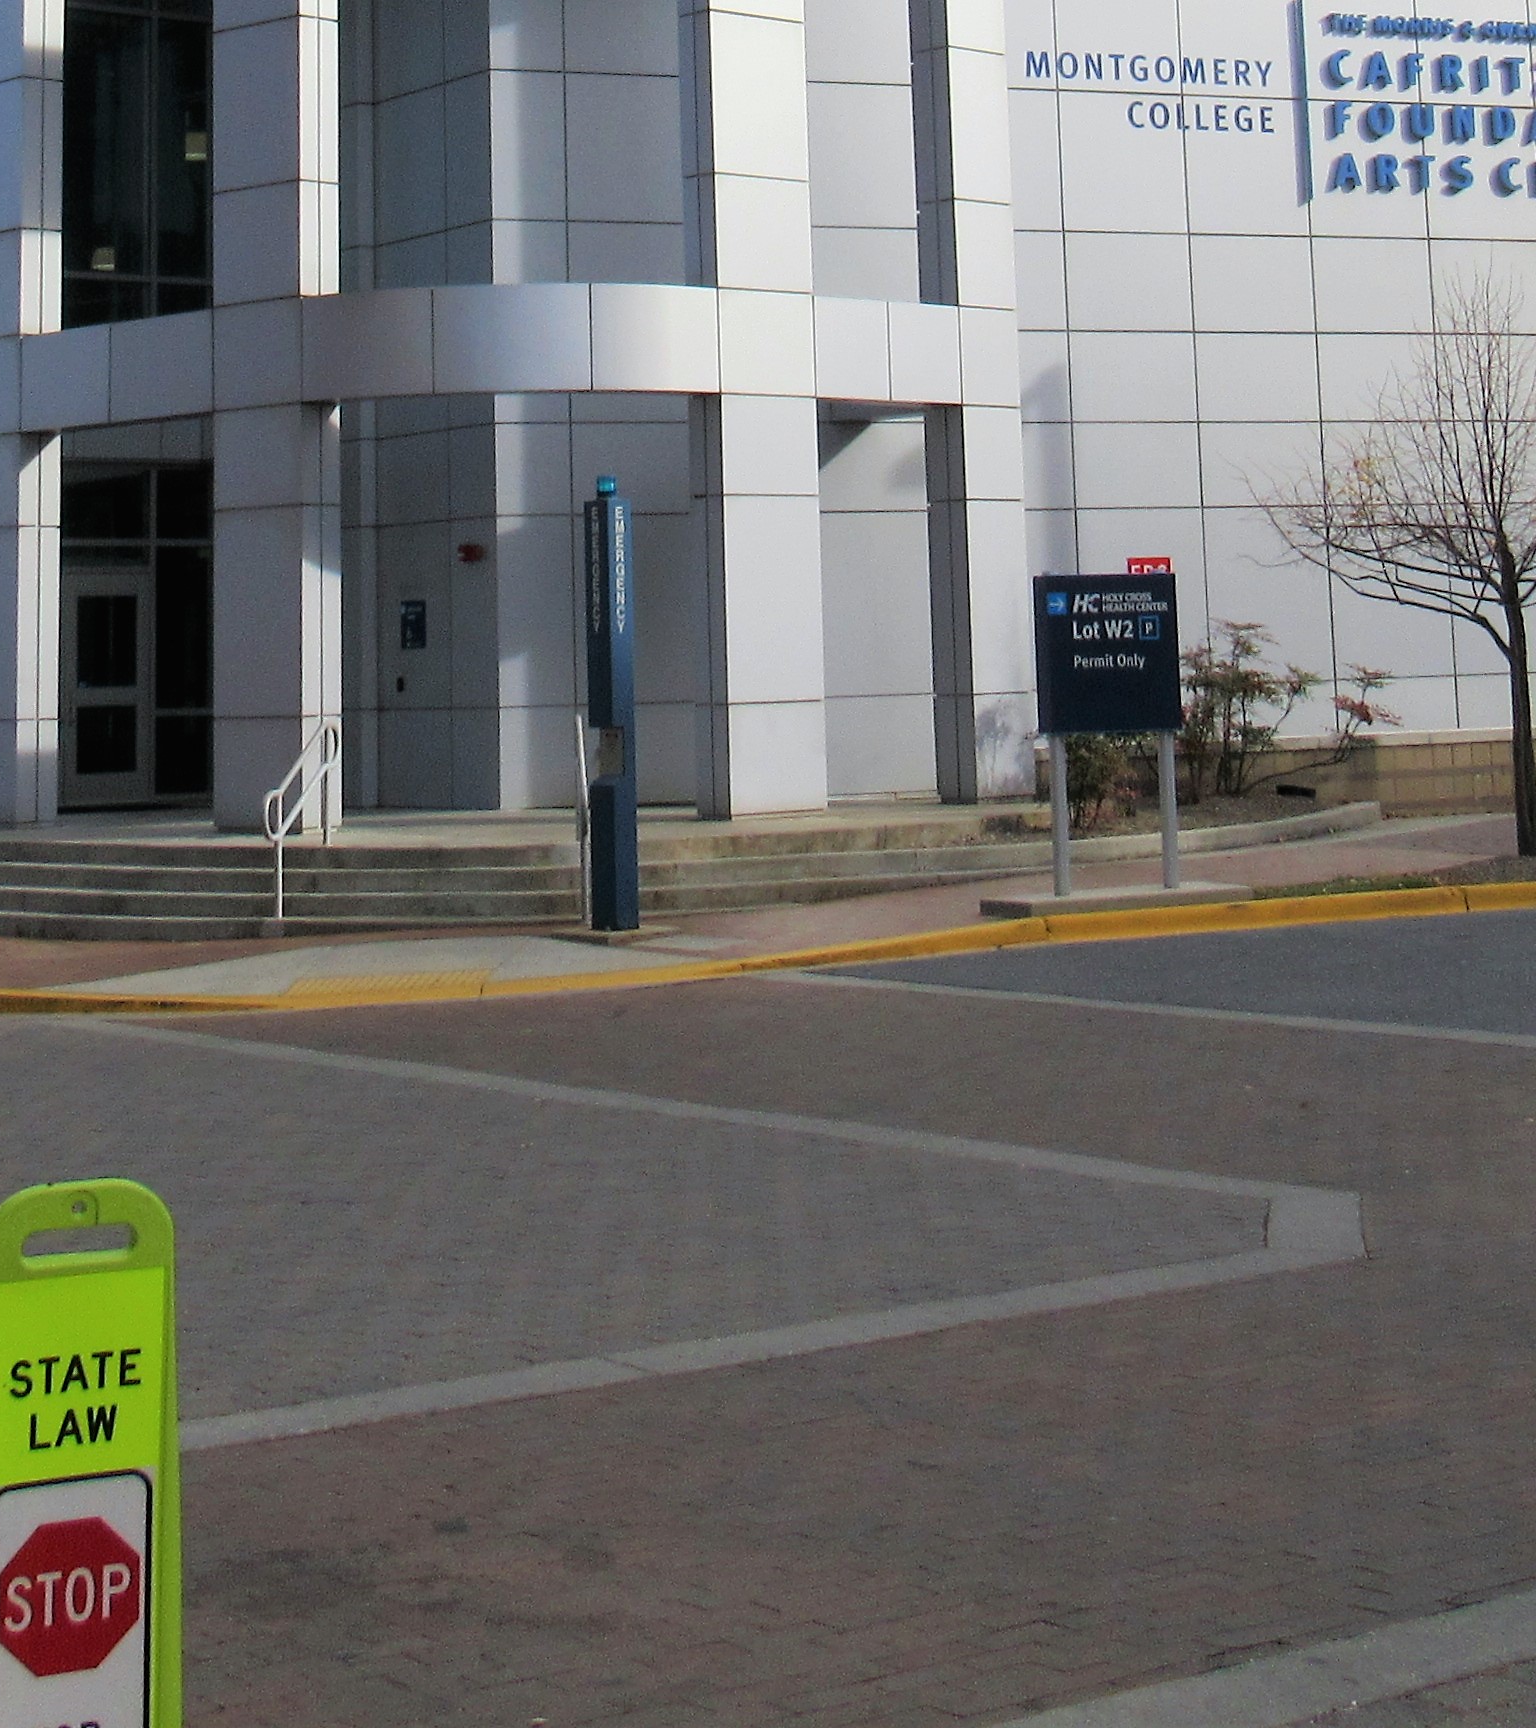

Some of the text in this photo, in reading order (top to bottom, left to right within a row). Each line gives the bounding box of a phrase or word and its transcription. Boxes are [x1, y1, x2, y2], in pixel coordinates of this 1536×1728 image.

[1319, 12, 1367, 38] THE
[1365, 15, 1454, 42] MORRIS
[1024, 50, 1272, 87] MONTGOMERY
[1127, 100, 1275, 133] COLLEGE
[1324, 152, 1475, 198] ARTS
[591, 507, 601, 633] EMERGENCY
[615, 506, 625, 633] EMERGENCY
[1102, 592, 1152, 602] HOLY CROSS
[1102, 602, 1135, 612] HEALTH
[1072, 620, 1101, 640] Lot
[1104, 619, 1134, 639] W2
[1073, 653, 1146, 669] Permit Only
[9, 1348, 142, 1398] STATE
[29, 1404, 118, 1451] LAW
[4, 1563, 132, 1634] STOP
